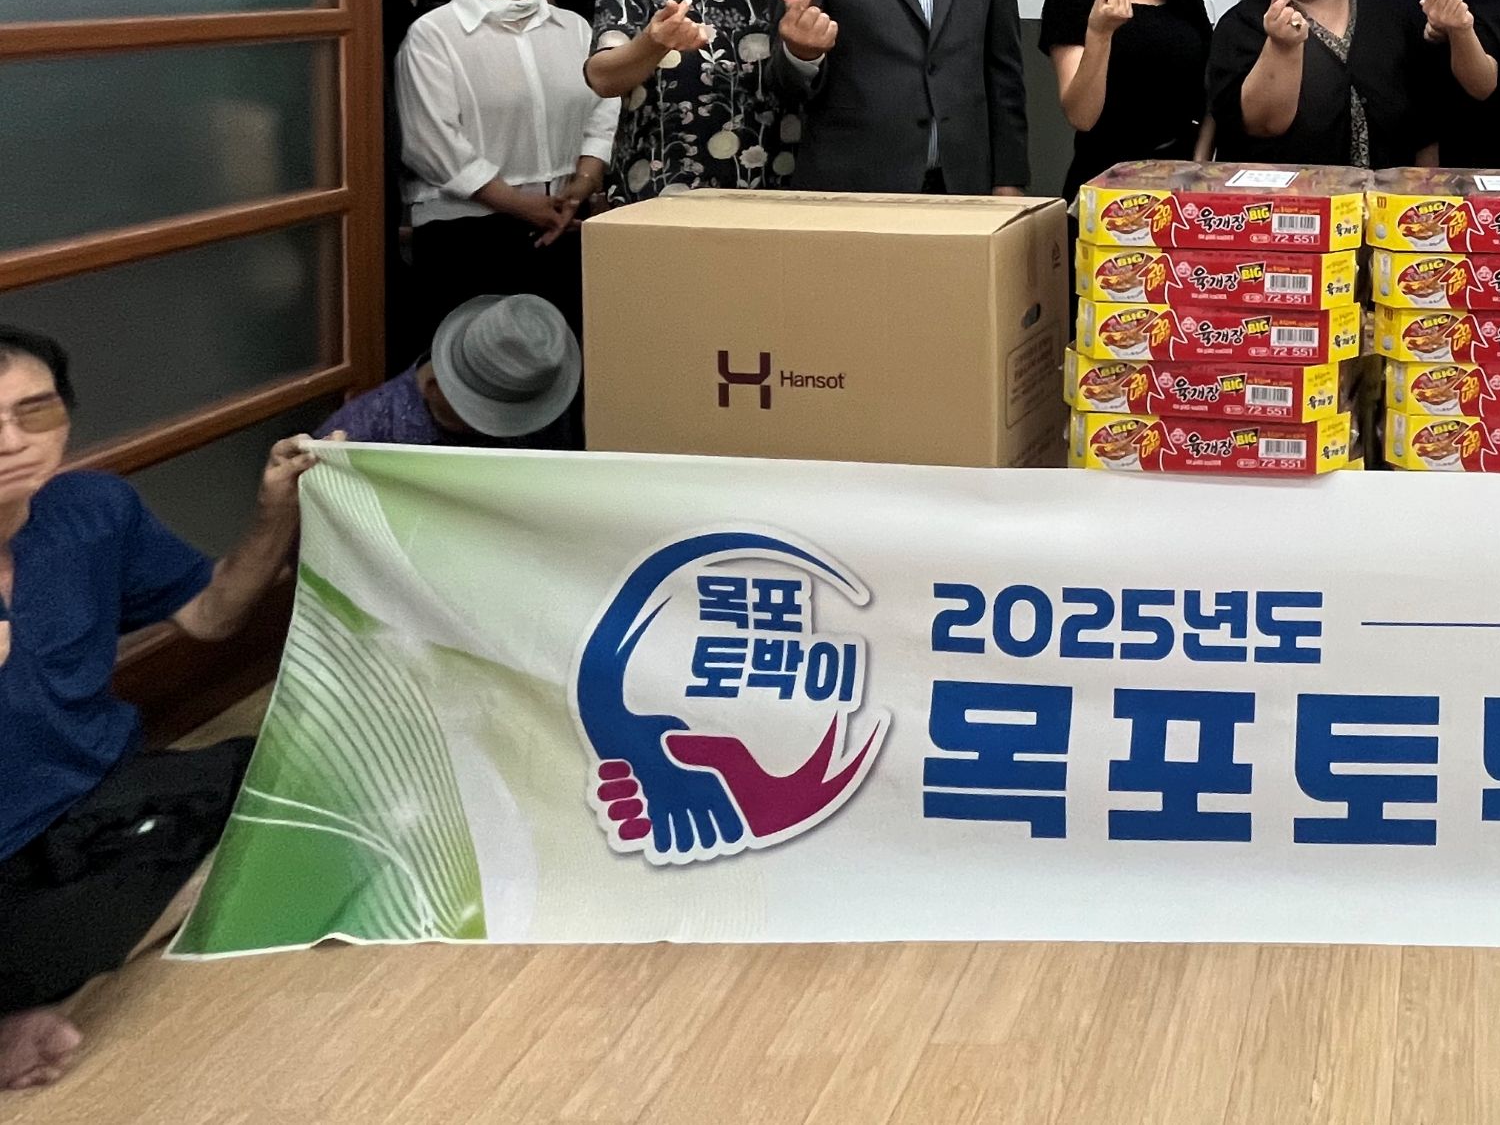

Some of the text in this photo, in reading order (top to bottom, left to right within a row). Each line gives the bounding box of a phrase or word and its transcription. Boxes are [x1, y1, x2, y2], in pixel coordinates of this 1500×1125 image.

[1124, 196, 1148, 208] BIG
[1419, 202, 1443, 214] BIG
[1197, 206, 1270, 231] 육개장 BIG
[1274, 234, 1316, 244] 72 551
[1118, 254, 1142, 266] BIG
[1419, 260, 1443, 272] BIG
[1190, 265, 1263, 290] 육개장 BIG
[1267, 293, 1308, 304] 72 551
[1122, 310, 1146, 322] BIG
[1424, 315, 1448, 327] BIG
[1196, 319, 1269, 345] 육개장 BIG
[1273, 347, 1315, 357] 72 551
[1101, 364, 1125, 376] BIG
[1432, 368, 1456, 380] BIG
[780, 370, 846, 389] Hansot
[1172, 377, 1244, 401] 육개장 BIG
[1247, 406, 1289, 416] 72 551
[1113, 422, 1137, 434] BIG
[1434, 422, 1458, 434] BIG
[1185, 431, 1257, 456] 육개장 BIG
[1261, 459, 1302, 469] 72 551
[696, 575, 802, 634] 목포
[932, 583, 1323, 664] 2025년도
[685, 637, 856, 703] 토박이
